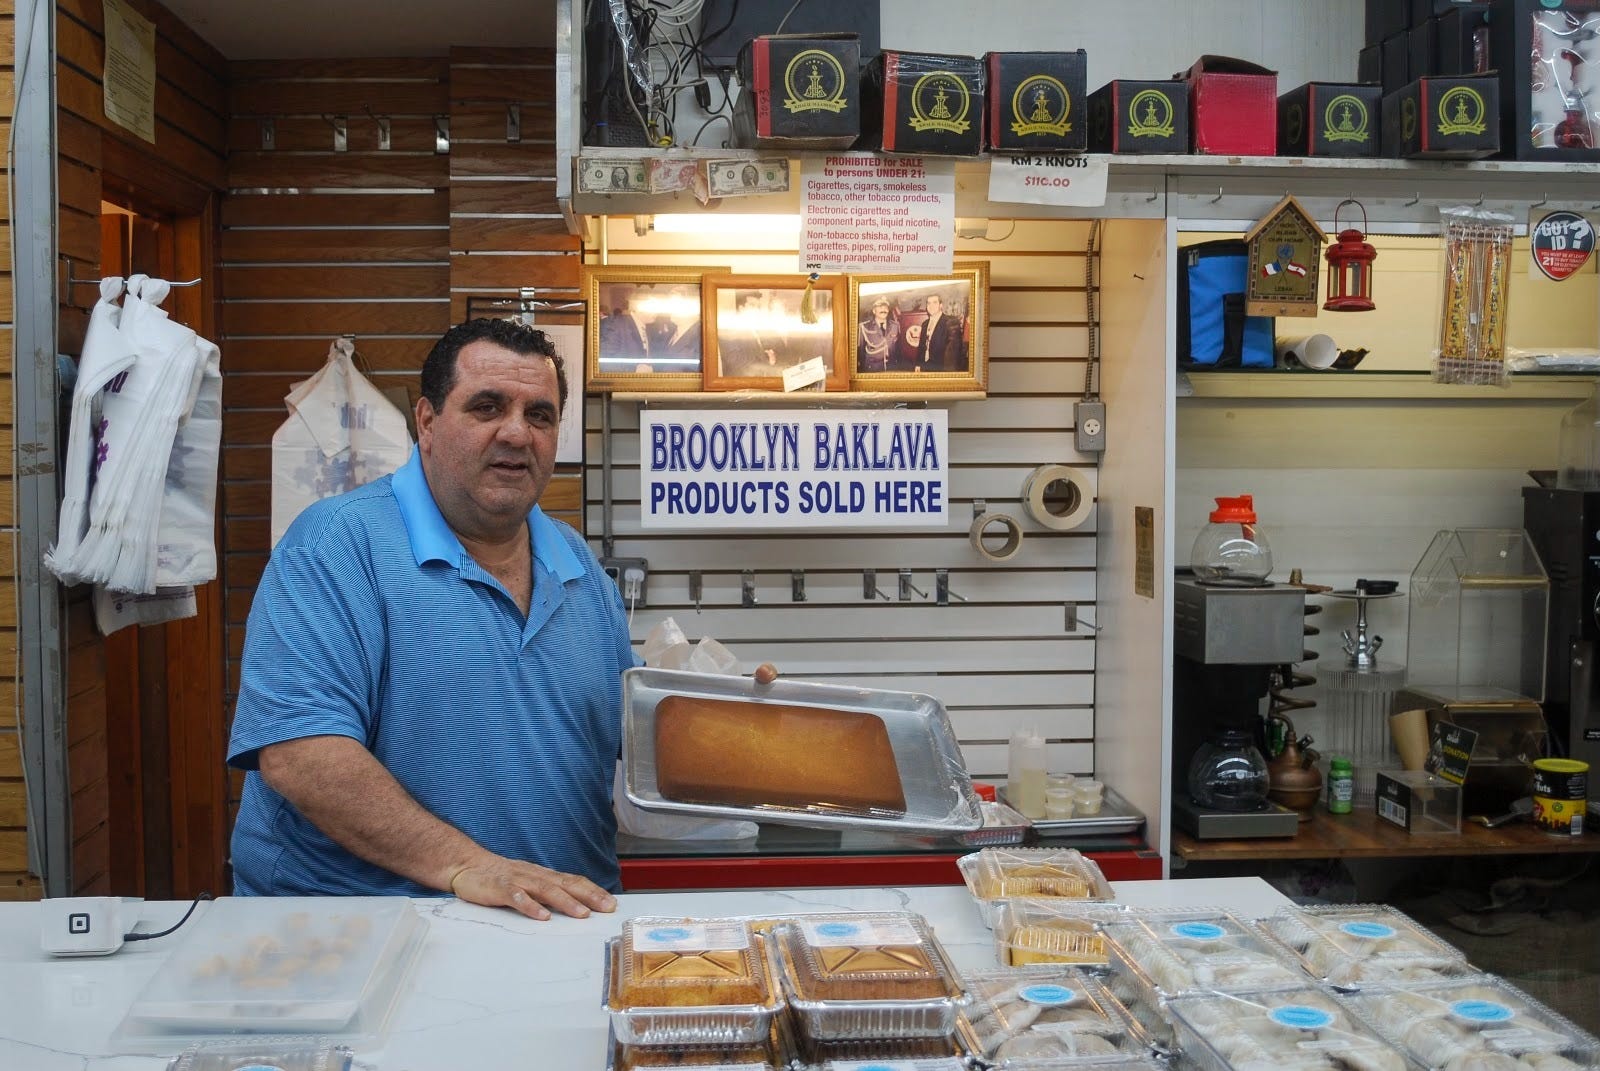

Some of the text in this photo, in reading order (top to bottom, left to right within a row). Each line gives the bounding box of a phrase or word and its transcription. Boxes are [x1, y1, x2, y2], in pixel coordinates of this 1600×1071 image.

[826, 157, 923, 168] PROHIBITED for SALE
[1011, 156, 1088, 168] KM 2 KNOTS
[837, 170, 874, 178] persons
[877, 169, 908, 178] UNDER
[911, 170, 926, 178] 21:
[808, 181, 926, 192] Cigarettes, cigars, smokeless
[808, 192, 842, 202] tobacco,
[868, 194, 900, 202] tobacco
[903, 194, 941, 203] products,
[808, 205, 908, 216] Electronic cigarettes and
[808, 218, 940, 228] component parts, liquid nicotine,
[1542, 220, 1570, 236] GOT
[807, 230, 918, 241] Non-tobacco shisha, herbal
[807, 242, 850, 251] cigarettes,
[852, 243, 876, 252] pipes,
[878, 243, 904, 252] rolling
[906, 245, 936, 254] papers,
[1551, 236, 1566, 250] ID
[807, 253, 900, 263] smoking paraphernalia
[1542, 256, 1554, 266] 21
[650, 423, 939, 472] BROOKLYN BAKLAVA
[651, 481, 942, 514] PRODUCTS SOLD HERE
